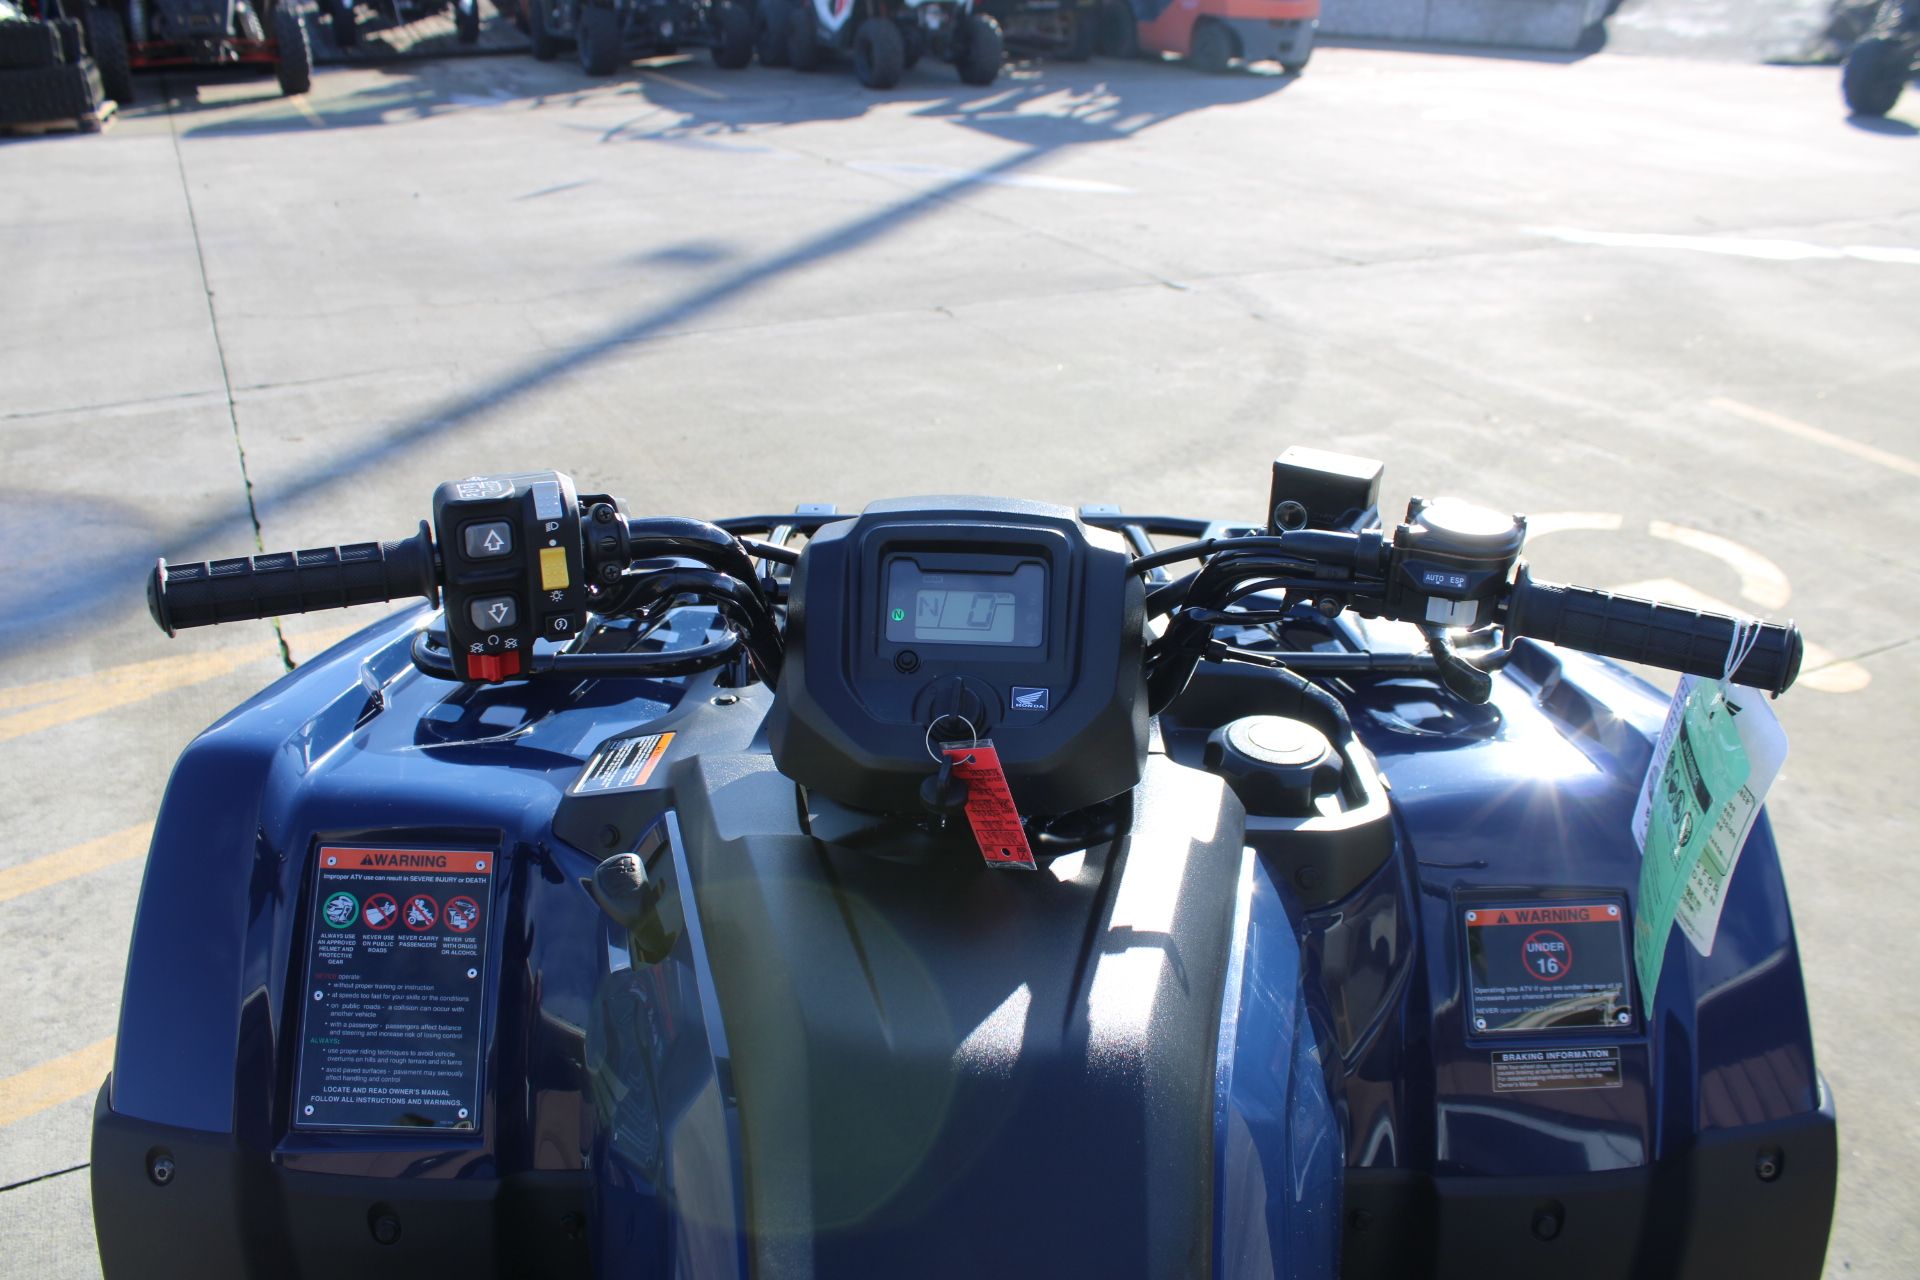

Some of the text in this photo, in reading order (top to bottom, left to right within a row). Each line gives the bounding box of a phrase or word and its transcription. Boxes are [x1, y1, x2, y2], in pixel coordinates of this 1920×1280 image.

[1426, 574, 1464, 584] AUTO ESP
[919, 593, 996, 627] N 0
[374, 854, 447, 868] WARNING
[1516, 908, 1590, 922] WARNING
[1526, 942, 1565, 952] UNDER
[1537, 958, 1558, 973] 16
[1502, 1050, 1609, 1061] BRAKING INFORMATION
